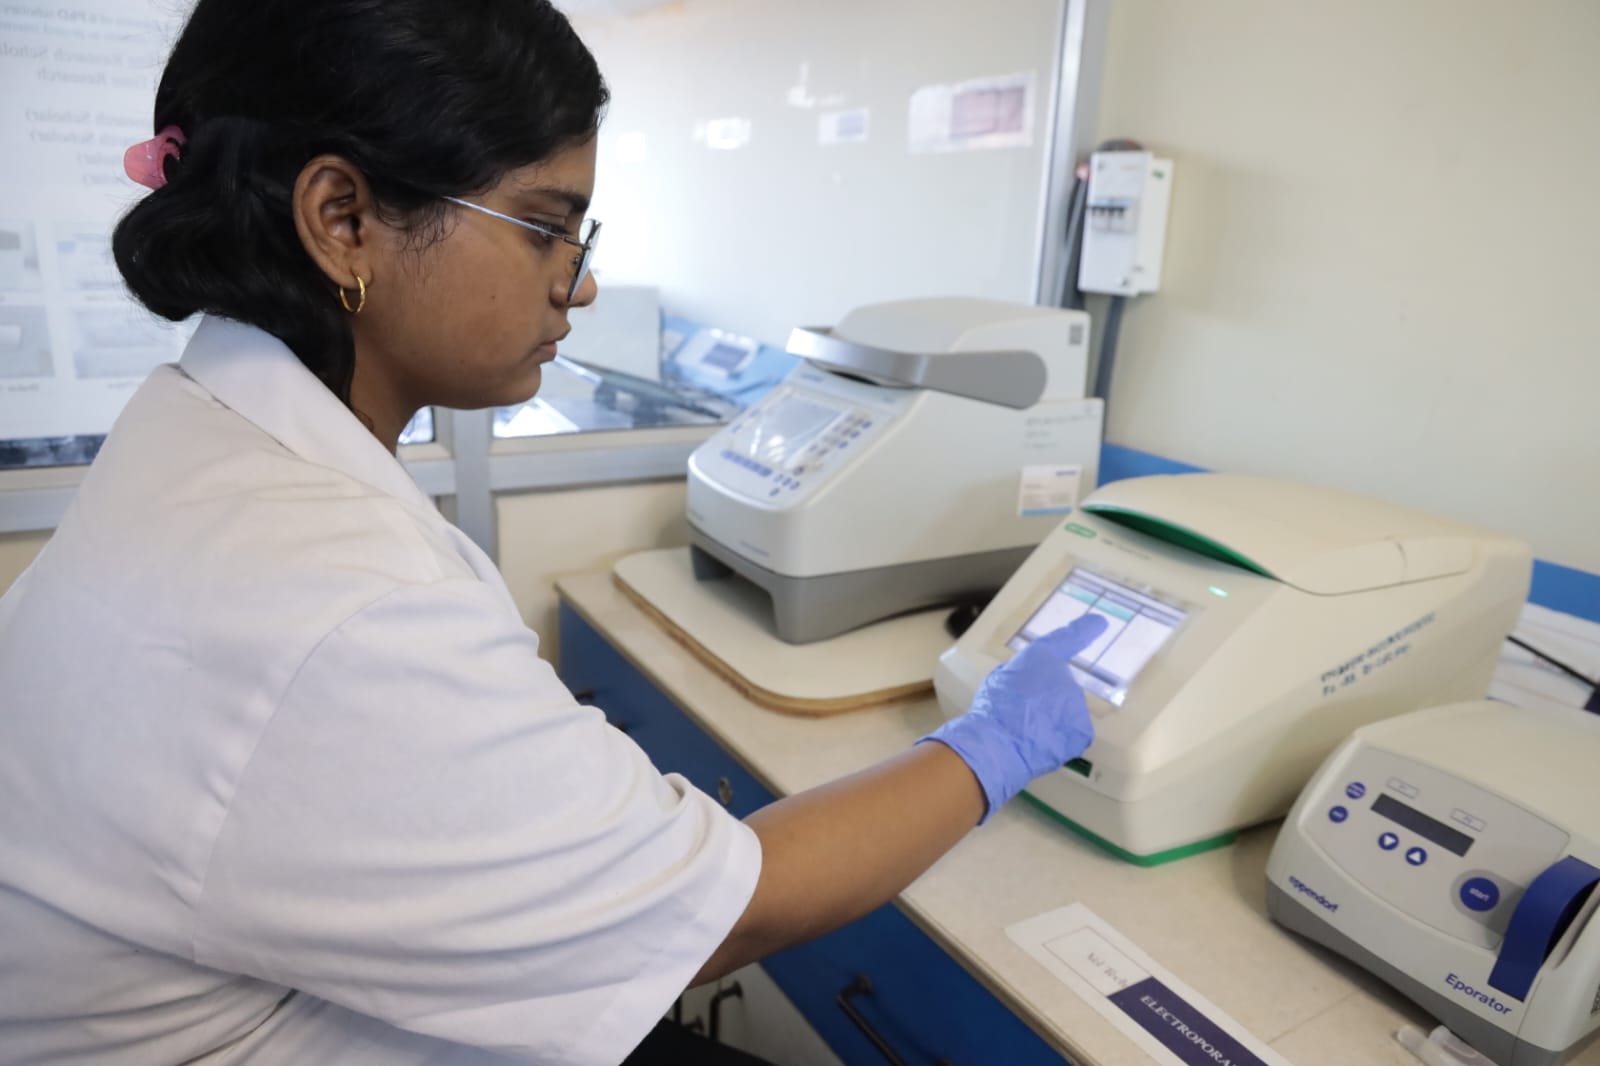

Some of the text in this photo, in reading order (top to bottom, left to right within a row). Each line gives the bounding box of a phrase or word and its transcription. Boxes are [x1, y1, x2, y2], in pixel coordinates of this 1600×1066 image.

[1288, 875, 1339, 912] eppendorf
[1445, 972, 1512, 1015] Eporator
[1140, 995, 1238, 1066] ELECTROPORA
